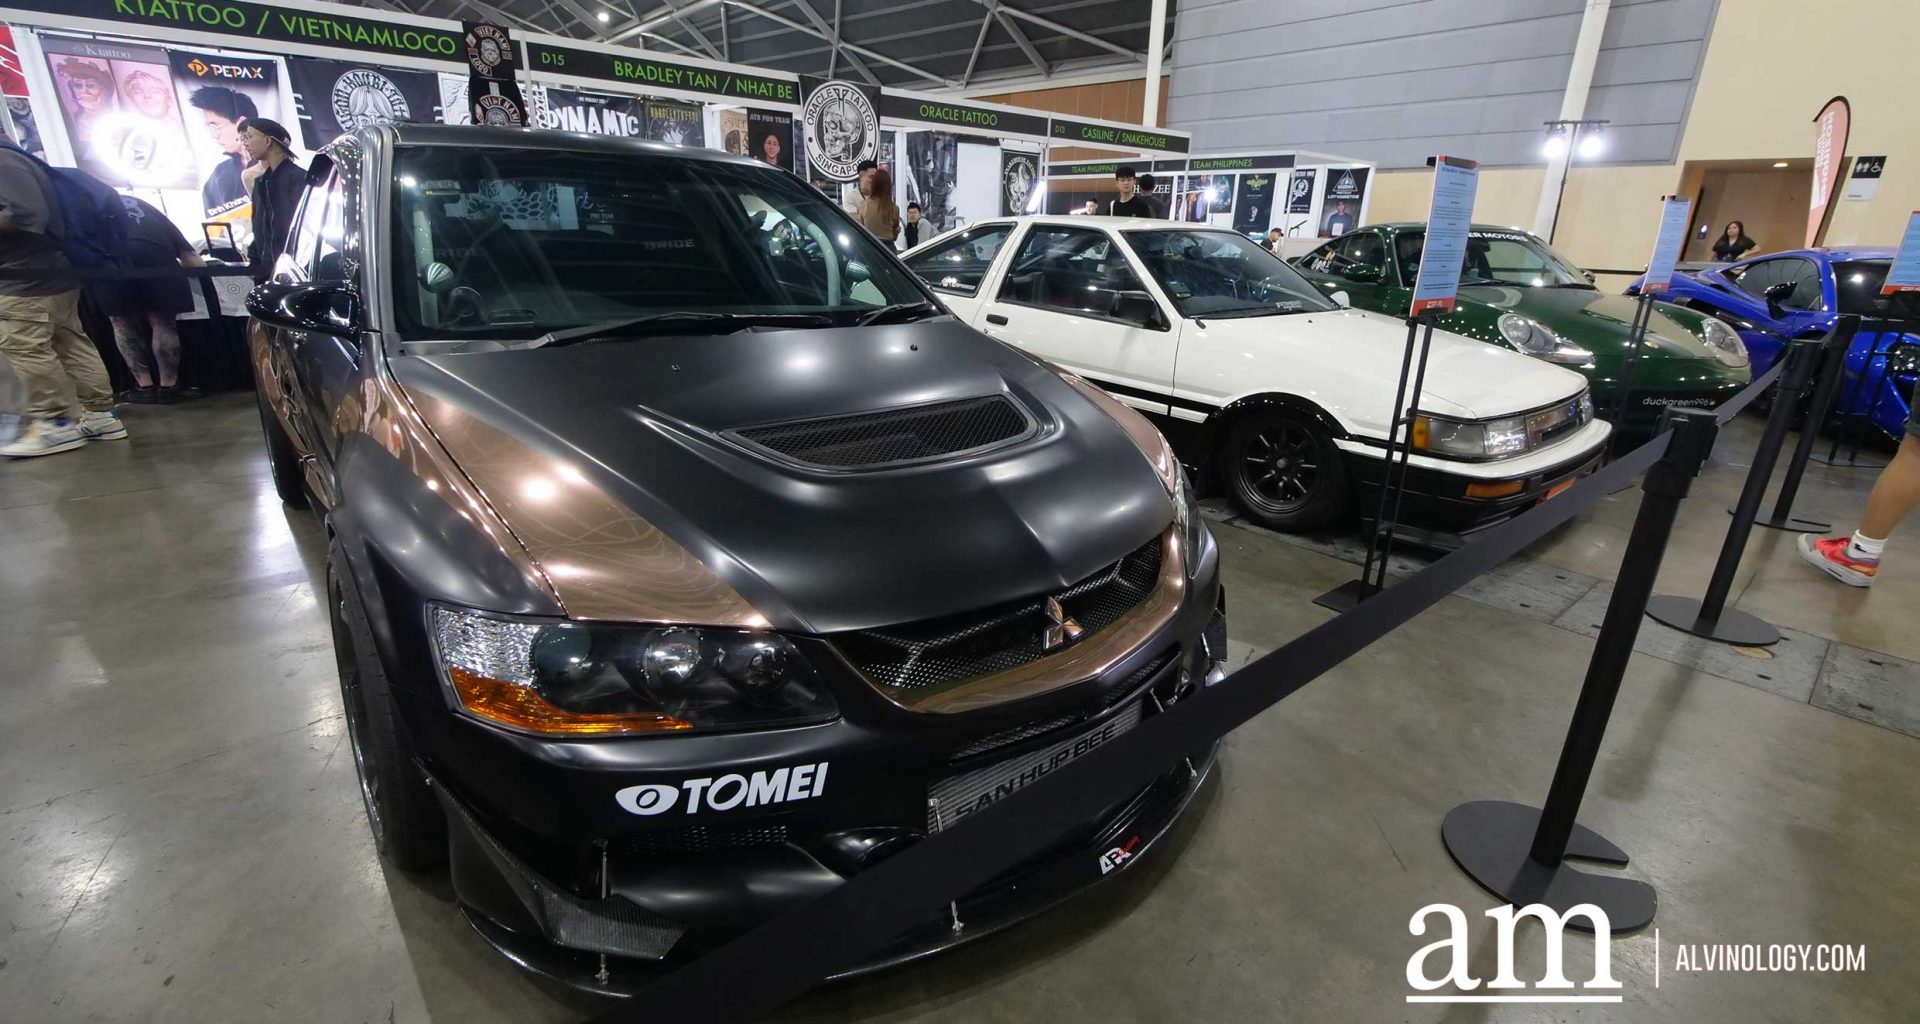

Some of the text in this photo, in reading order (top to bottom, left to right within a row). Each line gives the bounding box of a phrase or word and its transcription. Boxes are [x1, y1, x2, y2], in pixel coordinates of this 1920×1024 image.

[256, 10, 270, 35] /
[279, 14, 456, 54] VIETNAMLOCO
[211, 64, 264, 79] PEPAX
[541, 52, 793, 100] D15 BRADLEY TAN / NHAT BE
[548, 105, 639, 137] DYNAMIC
[806, 88, 874, 132] ORACLE TATTOO
[919, 104, 998, 127] ORACLE TATTOO
[1081, 127, 1115, 142] CASILINE
[1121, 132, 1167, 149] SNAKEHOUSE
[1072, 163, 1118, 173] TEAM PHILIPPINES
[1193, 158, 1253, 169] TEAM PHILIPPINES
[1642, 397, 1709, 408] duckgreen996
[956, 723, 1117, 816] SAN HUP BEE
[682, 761, 829, 815] TOMEI
